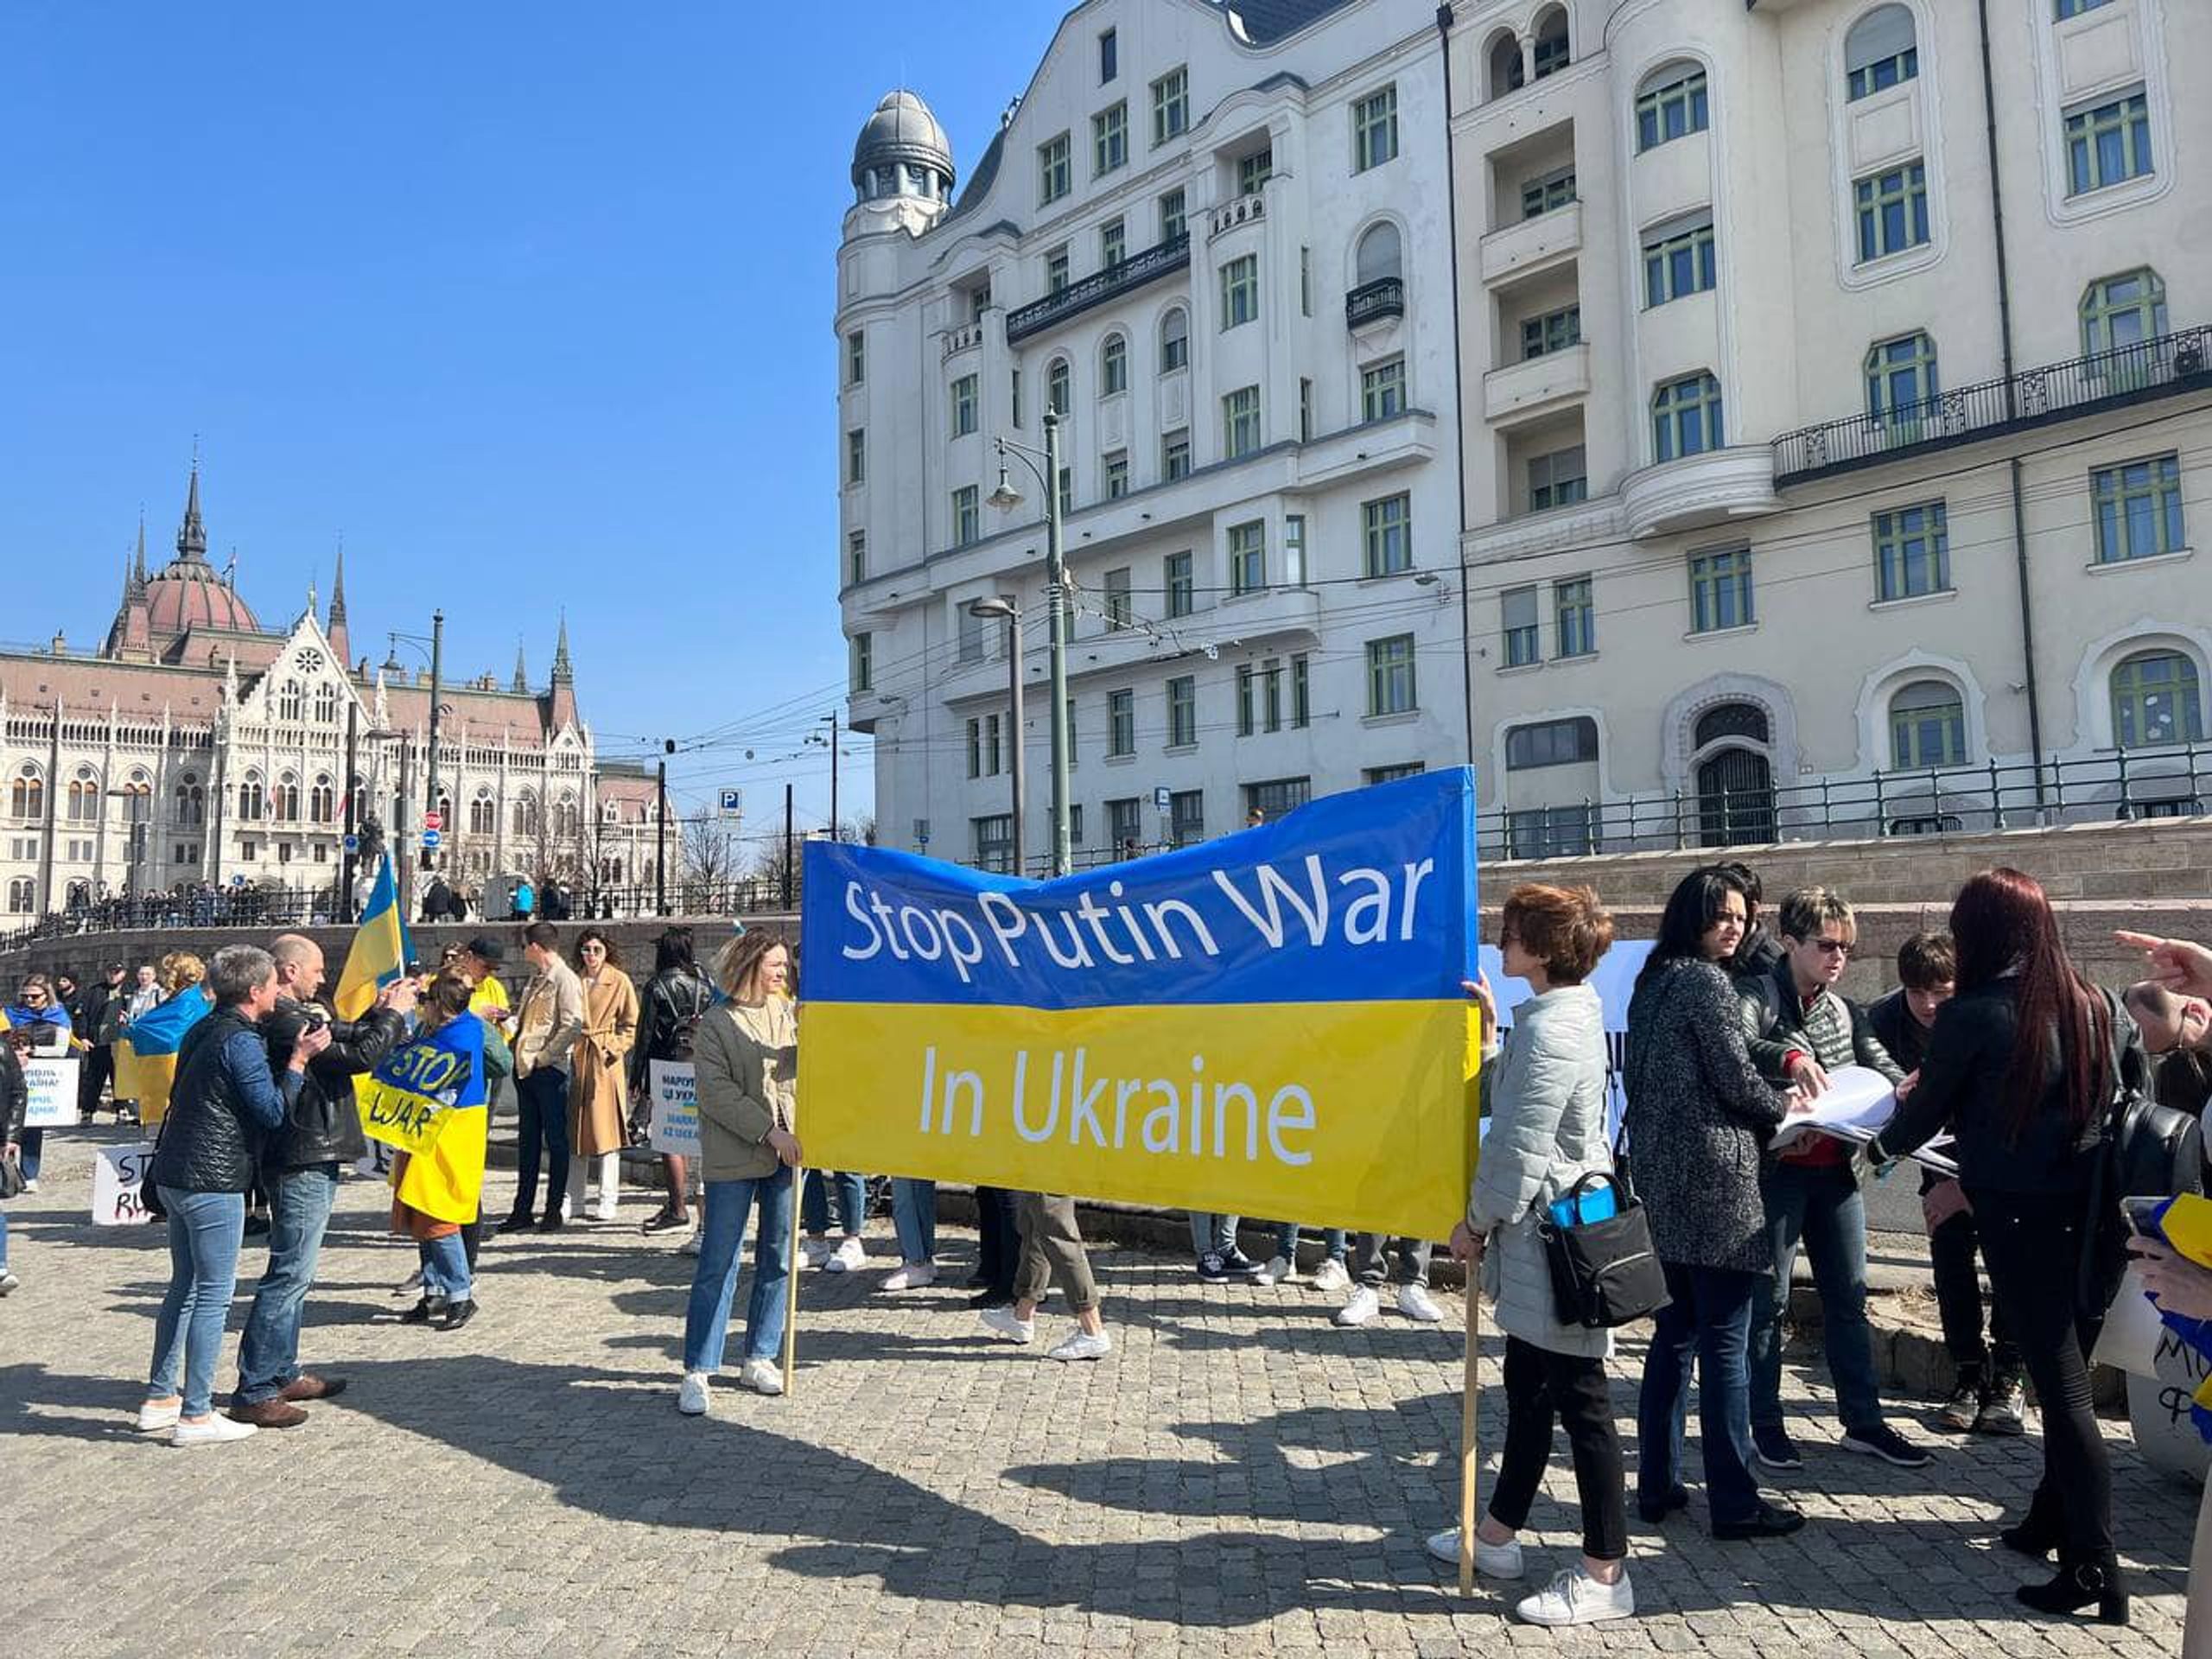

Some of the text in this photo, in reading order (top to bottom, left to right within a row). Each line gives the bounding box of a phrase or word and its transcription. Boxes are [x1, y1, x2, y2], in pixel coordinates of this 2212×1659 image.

[724, 793, 735, 807] P
[842, 854, 1433, 982] Stop Putin War
[369, 1090, 432, 1138] WAR
[920, 1046, 1316, 1166] In Ukraine
[118, 1154, 156, 1182] ST
[115, 1192, 149, 1218] RU
